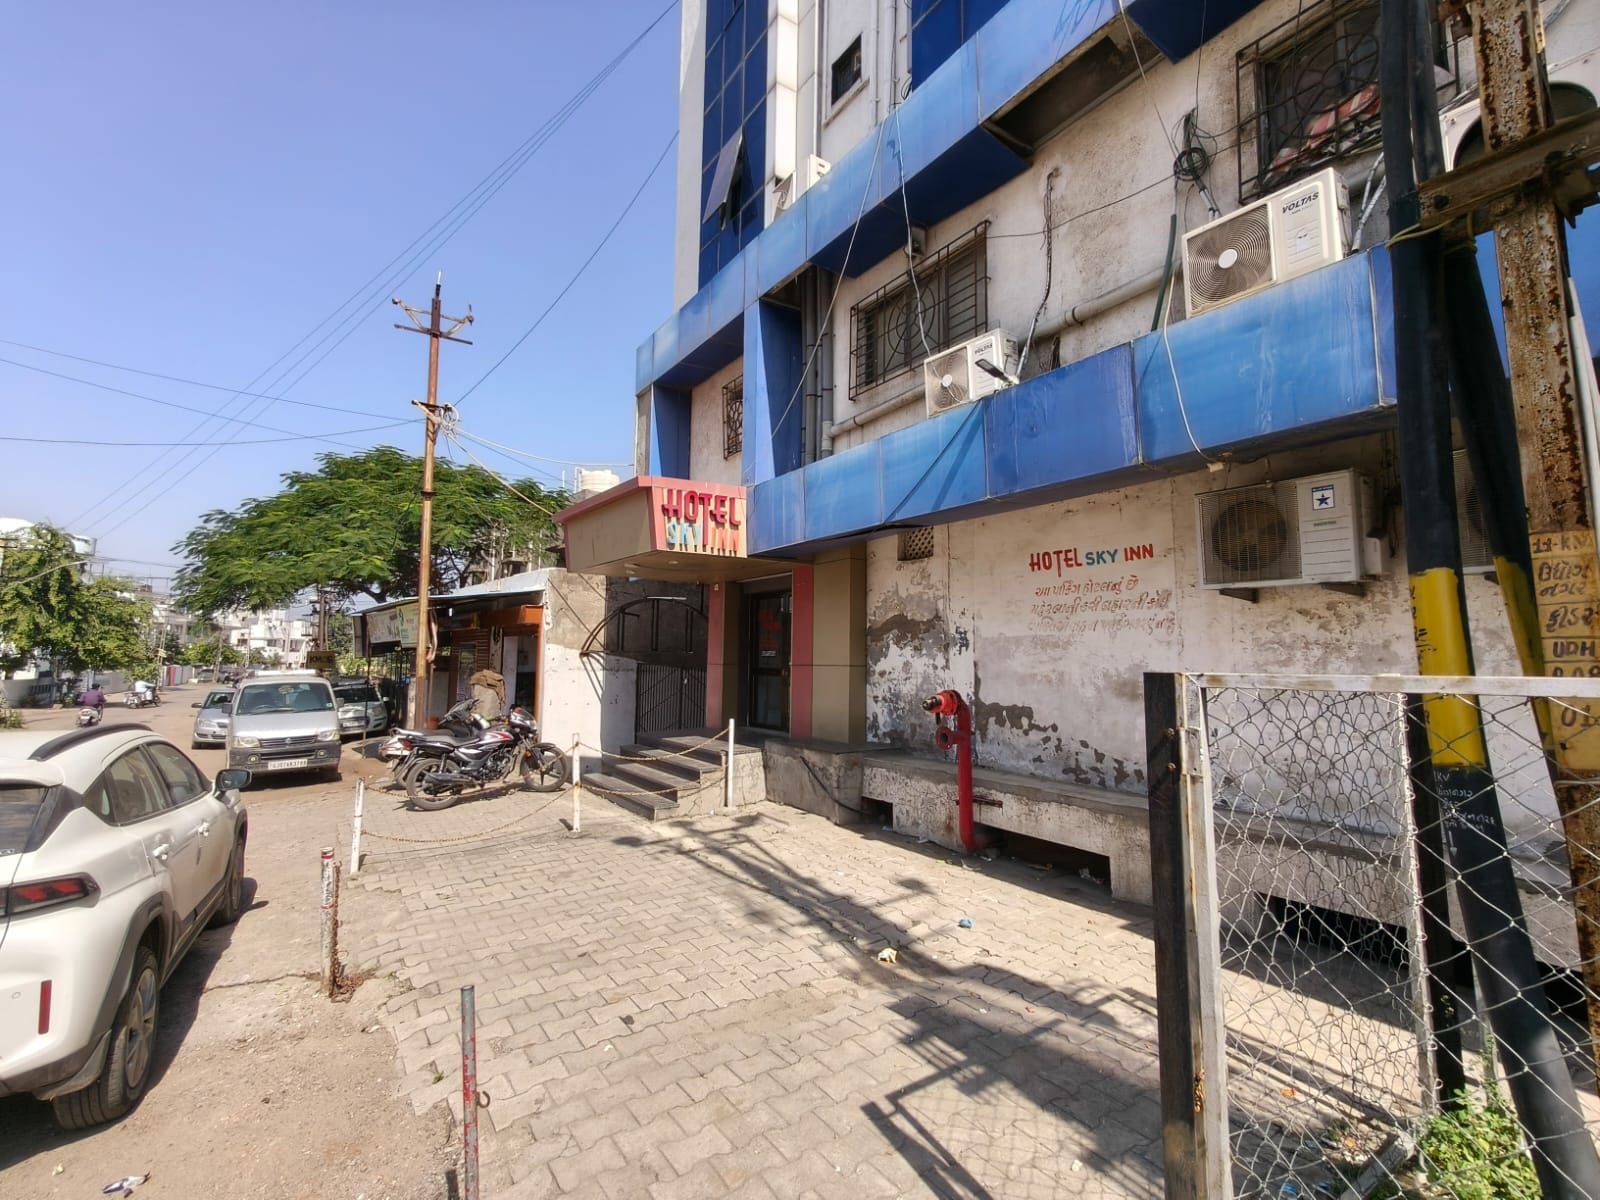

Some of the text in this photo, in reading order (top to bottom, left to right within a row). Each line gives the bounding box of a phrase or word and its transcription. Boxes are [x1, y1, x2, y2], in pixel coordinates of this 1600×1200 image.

[1282, 191, 1319, 214] VOLTAS
[662, 488, 741, 546] HOTEL
[667, 521, 740, 552] SKY INN
[1029, 544, 1154, 577] HOTEL SKY INN
[1552, 640, 1596, 658] UDH
